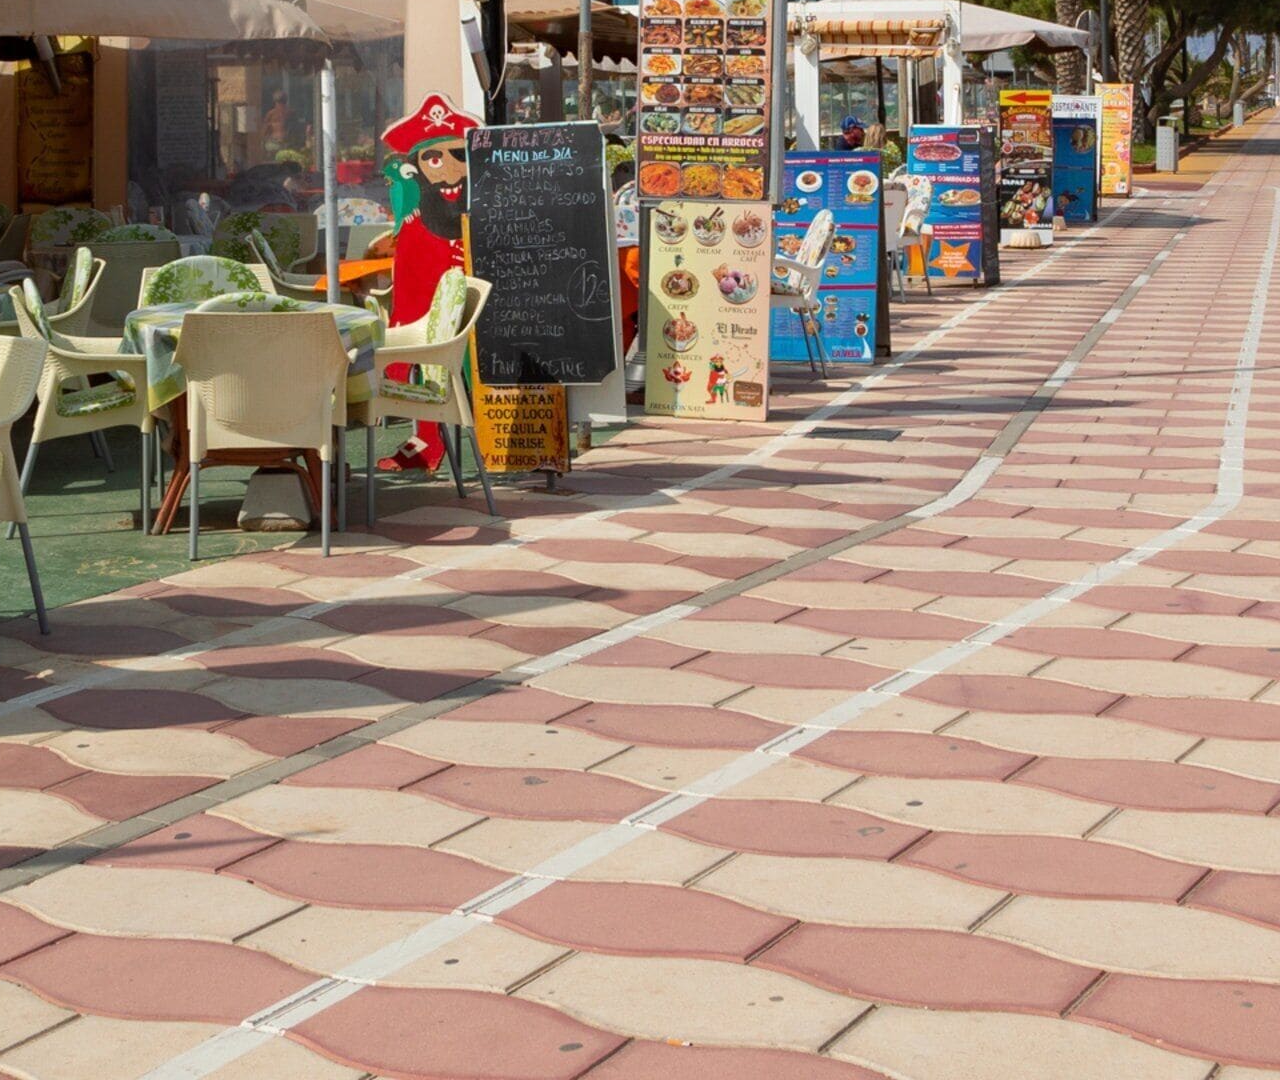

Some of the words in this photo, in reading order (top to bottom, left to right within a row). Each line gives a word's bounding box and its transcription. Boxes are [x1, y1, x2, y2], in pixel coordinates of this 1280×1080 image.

[471, 130, 492, 151] EL
[502, 128, 565, 147] PIRATA
[532, 150, 551, 160] DEL
[716, 323, 727, 334] El
[731, 323, 758, 336] Pirata
[522, 409, 553, 419] LOCO
[495, 438, 545, 449] SUNRISE
[491, 455, 537, 466] MUCHOS
